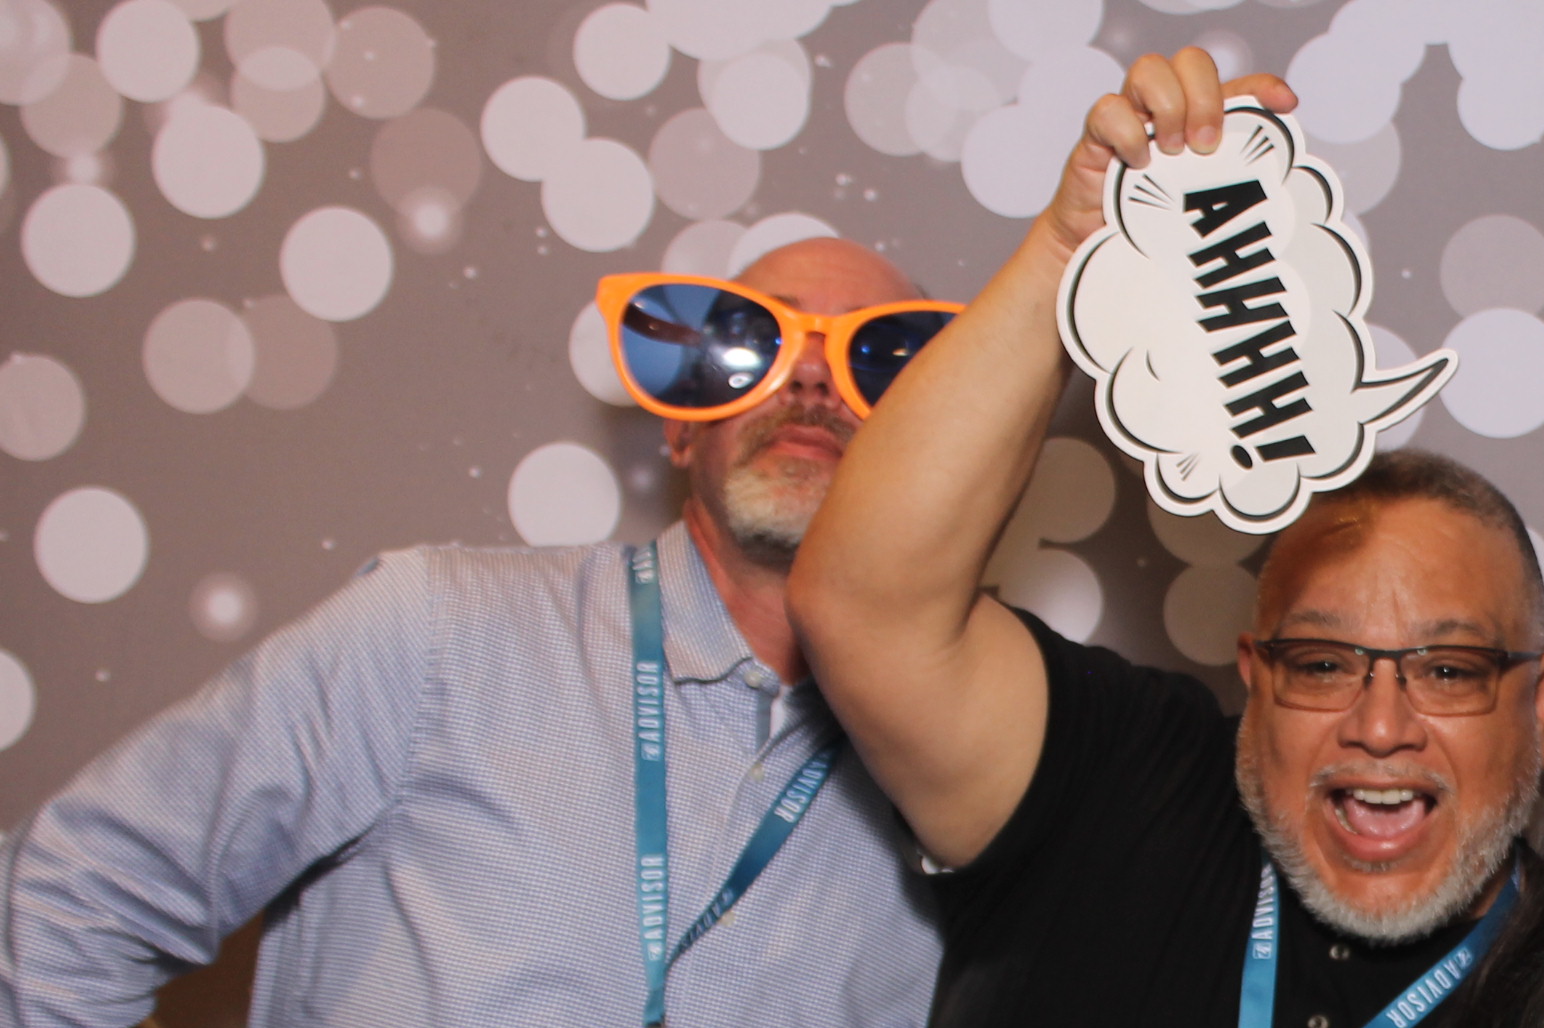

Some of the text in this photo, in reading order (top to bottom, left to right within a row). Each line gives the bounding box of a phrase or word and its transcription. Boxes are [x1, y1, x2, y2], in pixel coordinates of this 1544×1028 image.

[1182, 179, 1317, 470] AHHHH!
[637, 661, 661, 743] ADVISOR
[774, 760, 828, 824] ADVISOR
[640, 855, 665, 944] ADVISOR
[1251, 863, 1275, 940] ADVISOR
